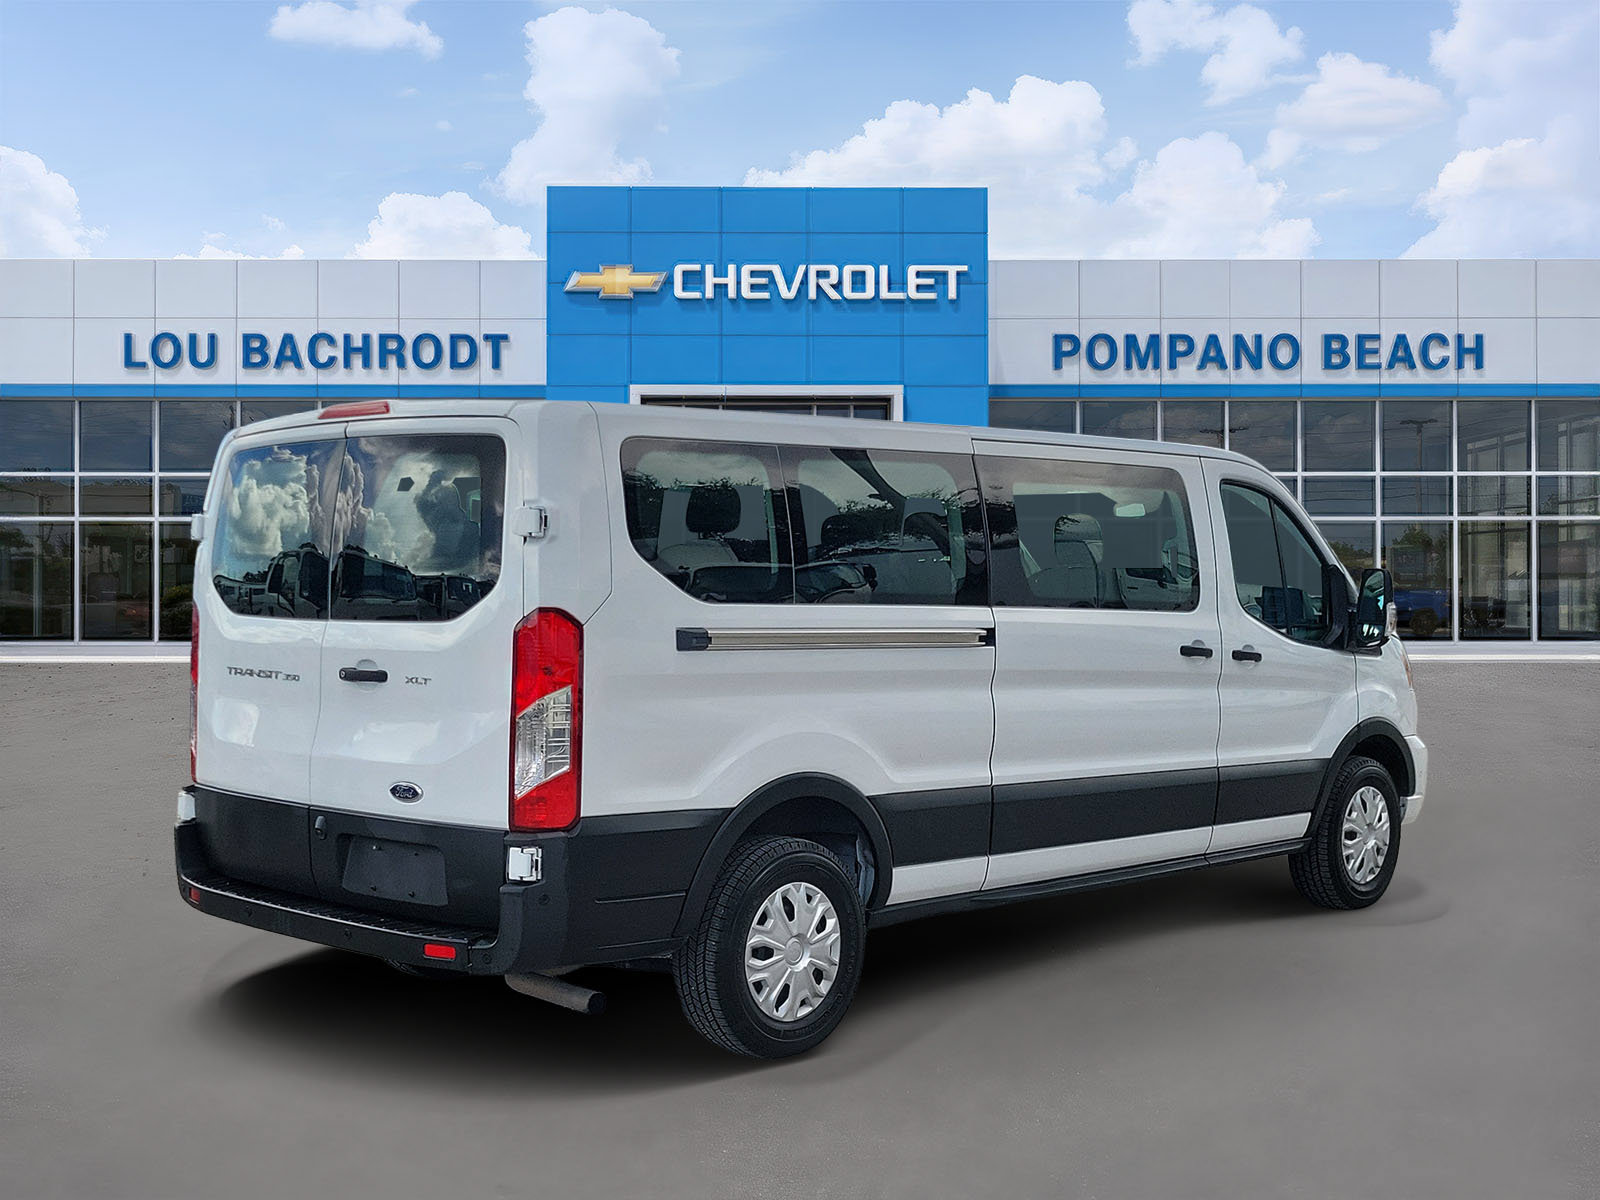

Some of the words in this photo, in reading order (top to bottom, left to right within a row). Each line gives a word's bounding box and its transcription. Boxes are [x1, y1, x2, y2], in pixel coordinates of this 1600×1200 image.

[673, 263, 969, 301] CHEVROLET
[123, 332, 219, 371] LOU
[241, 332, 509, 371] BACHRODT
[1052, 332, 1301, 371] POMPANO
[1321, 332, 1484, 371] BEACH
[227, 666, 283, 680] TRANSIT
[283, 673, 300, 682] 350
[405, 675, 432, 686] XLT
[393, 783, 417, 799] Ford
